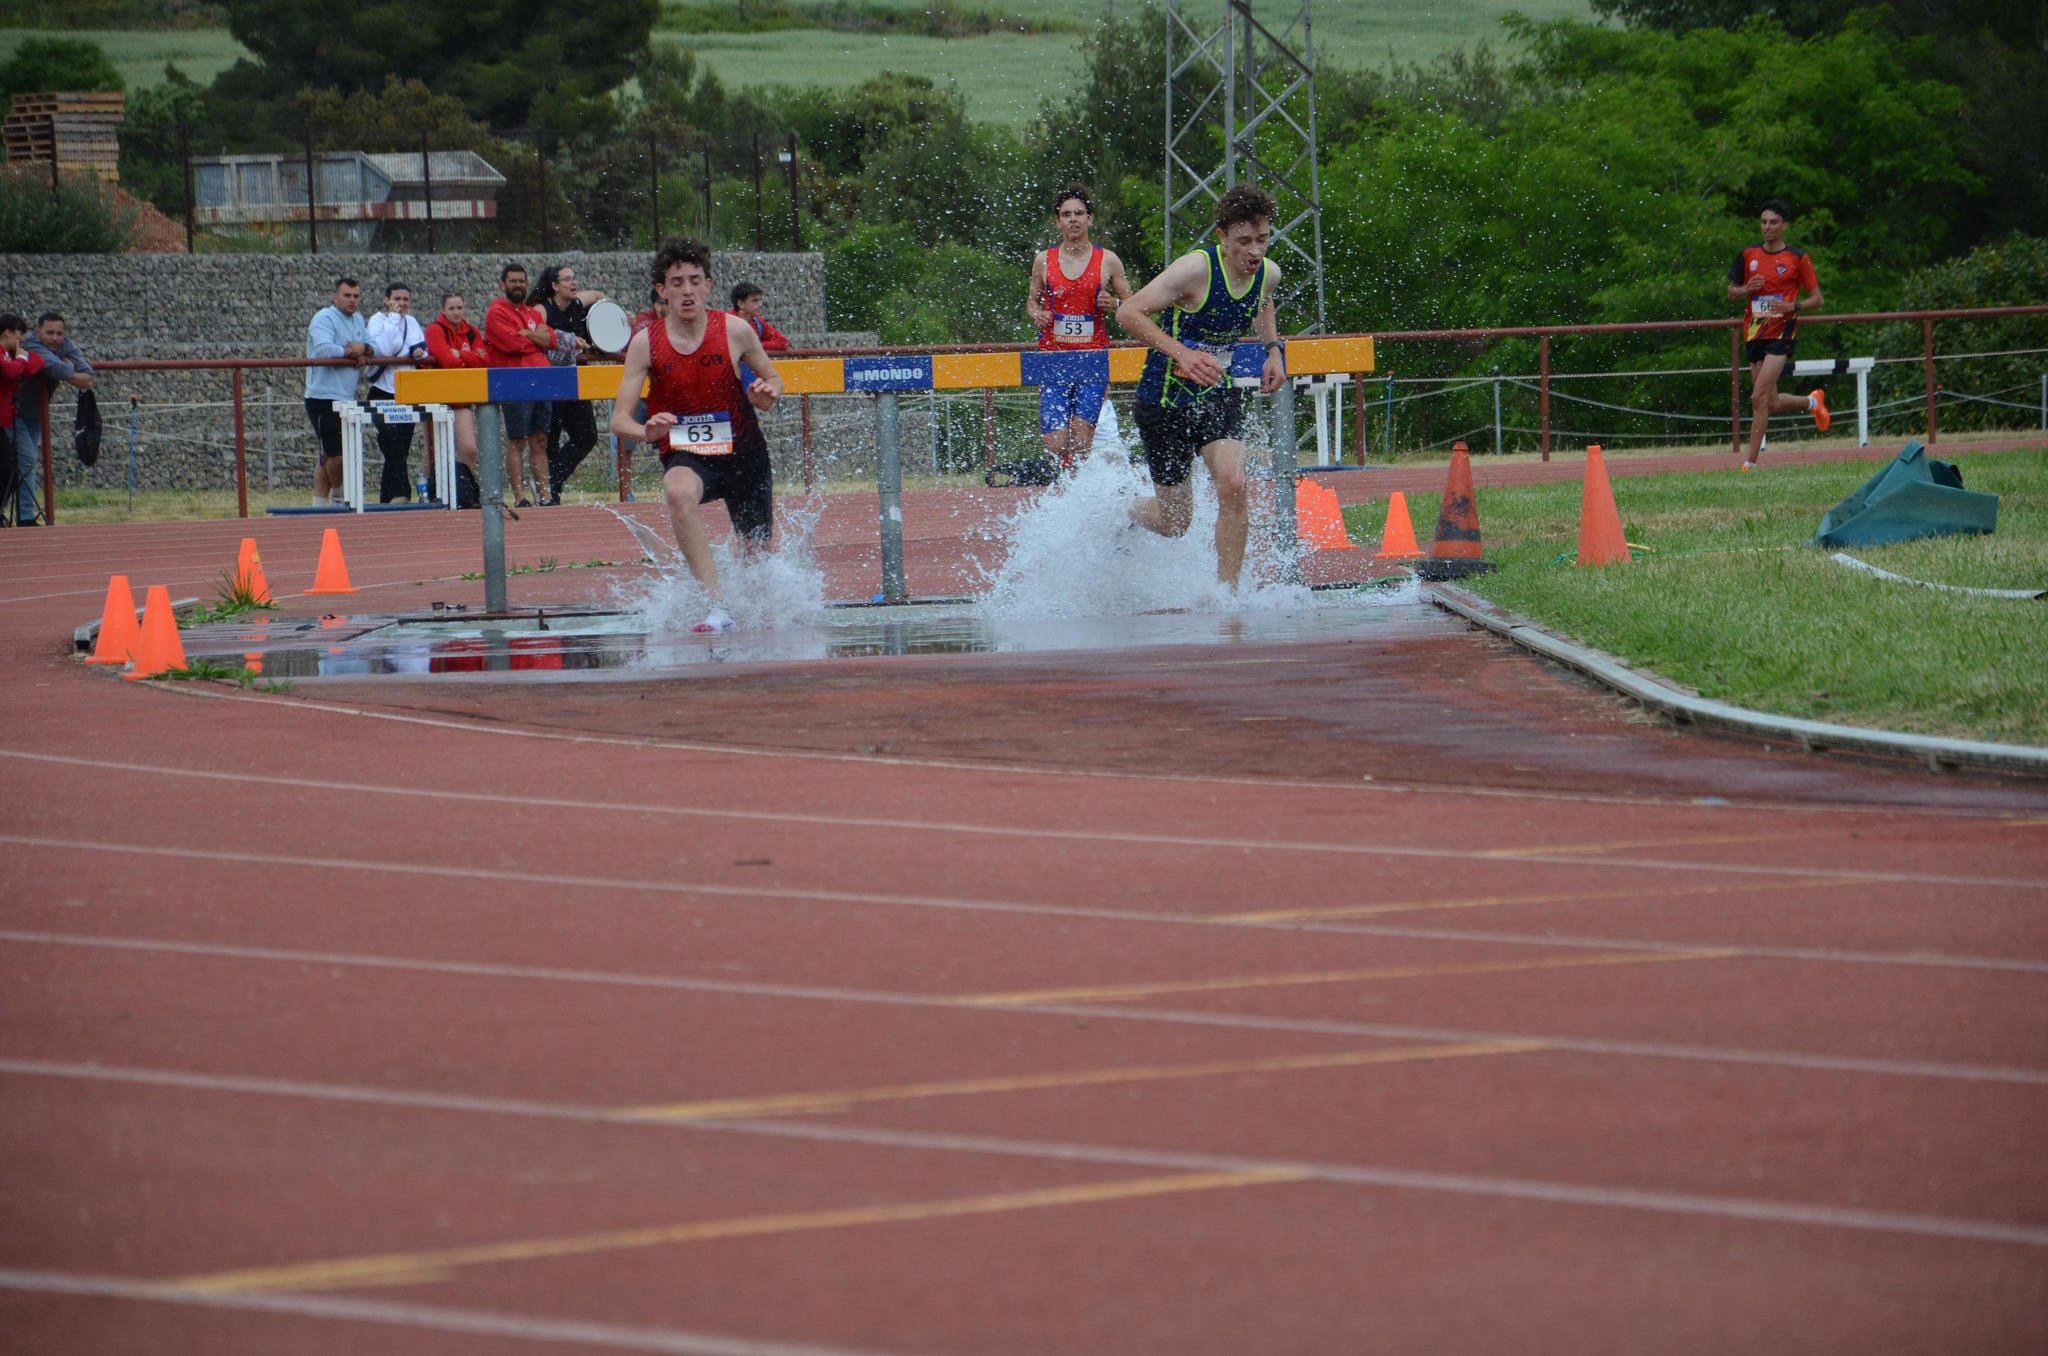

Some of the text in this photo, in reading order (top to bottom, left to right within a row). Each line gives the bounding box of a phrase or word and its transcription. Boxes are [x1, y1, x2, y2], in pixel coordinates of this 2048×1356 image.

[1065, 323, 1083, 335] 53
[864, 368, 923, 381] MONDO
[388, 414, 413, 422] MONDO
[687, 424, 714, 443] 63
